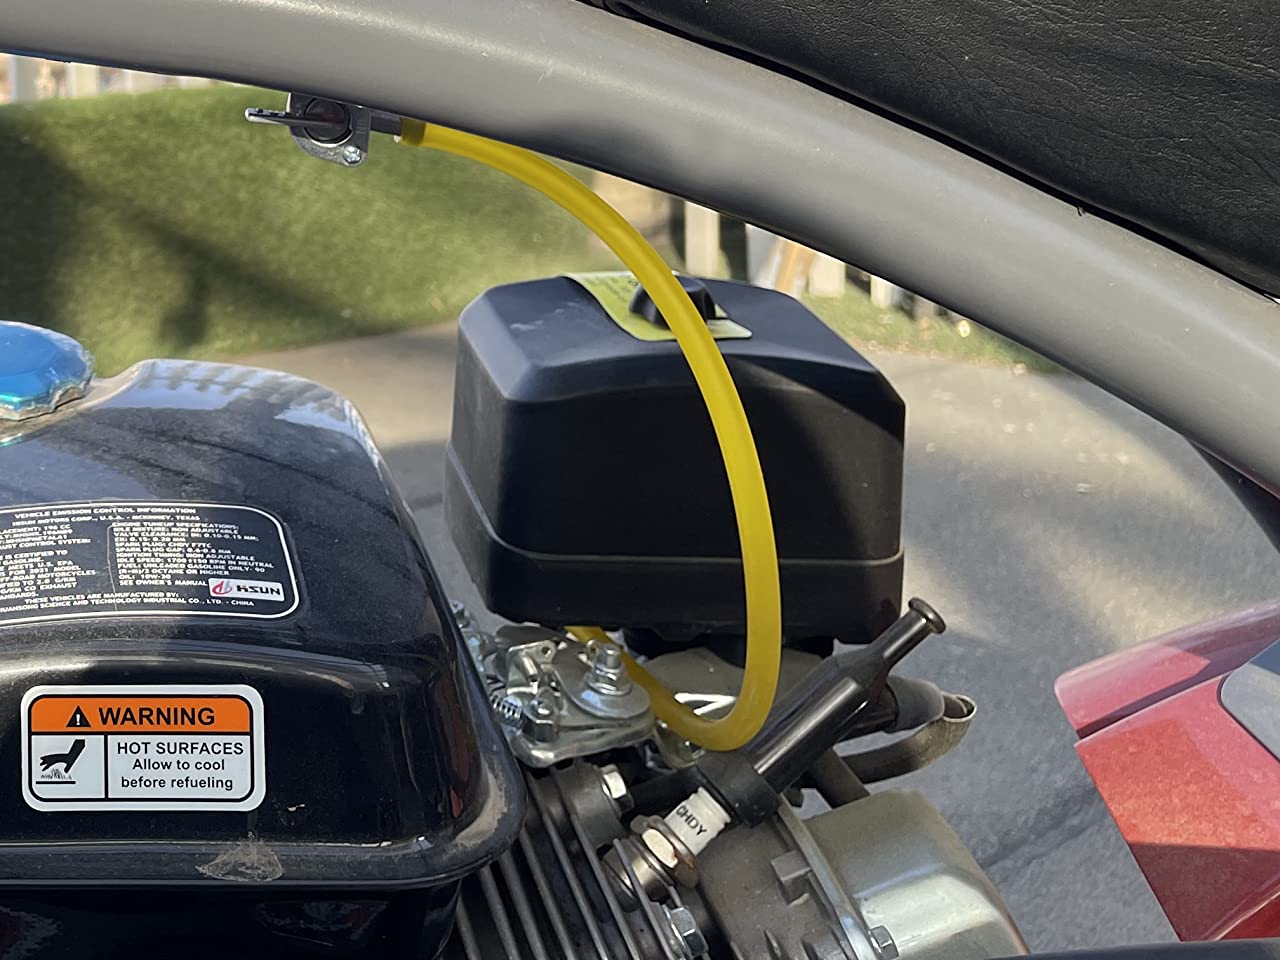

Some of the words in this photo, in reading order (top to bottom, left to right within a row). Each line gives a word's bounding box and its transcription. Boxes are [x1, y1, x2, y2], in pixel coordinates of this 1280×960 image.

[99, 707, 215, 726] WARNING
[117, 742, 151, 755] HOT
[156, 742, 244, 755] SURFACES
[132, 758, 172, 771] Allow
[176, 759, 191, 771] to
[194, 758, 225, 771] cool
[121, 776, 166, 789] before
[170, 776, 234, 791] refueling
[676, 805, 707, 836] CHDY
